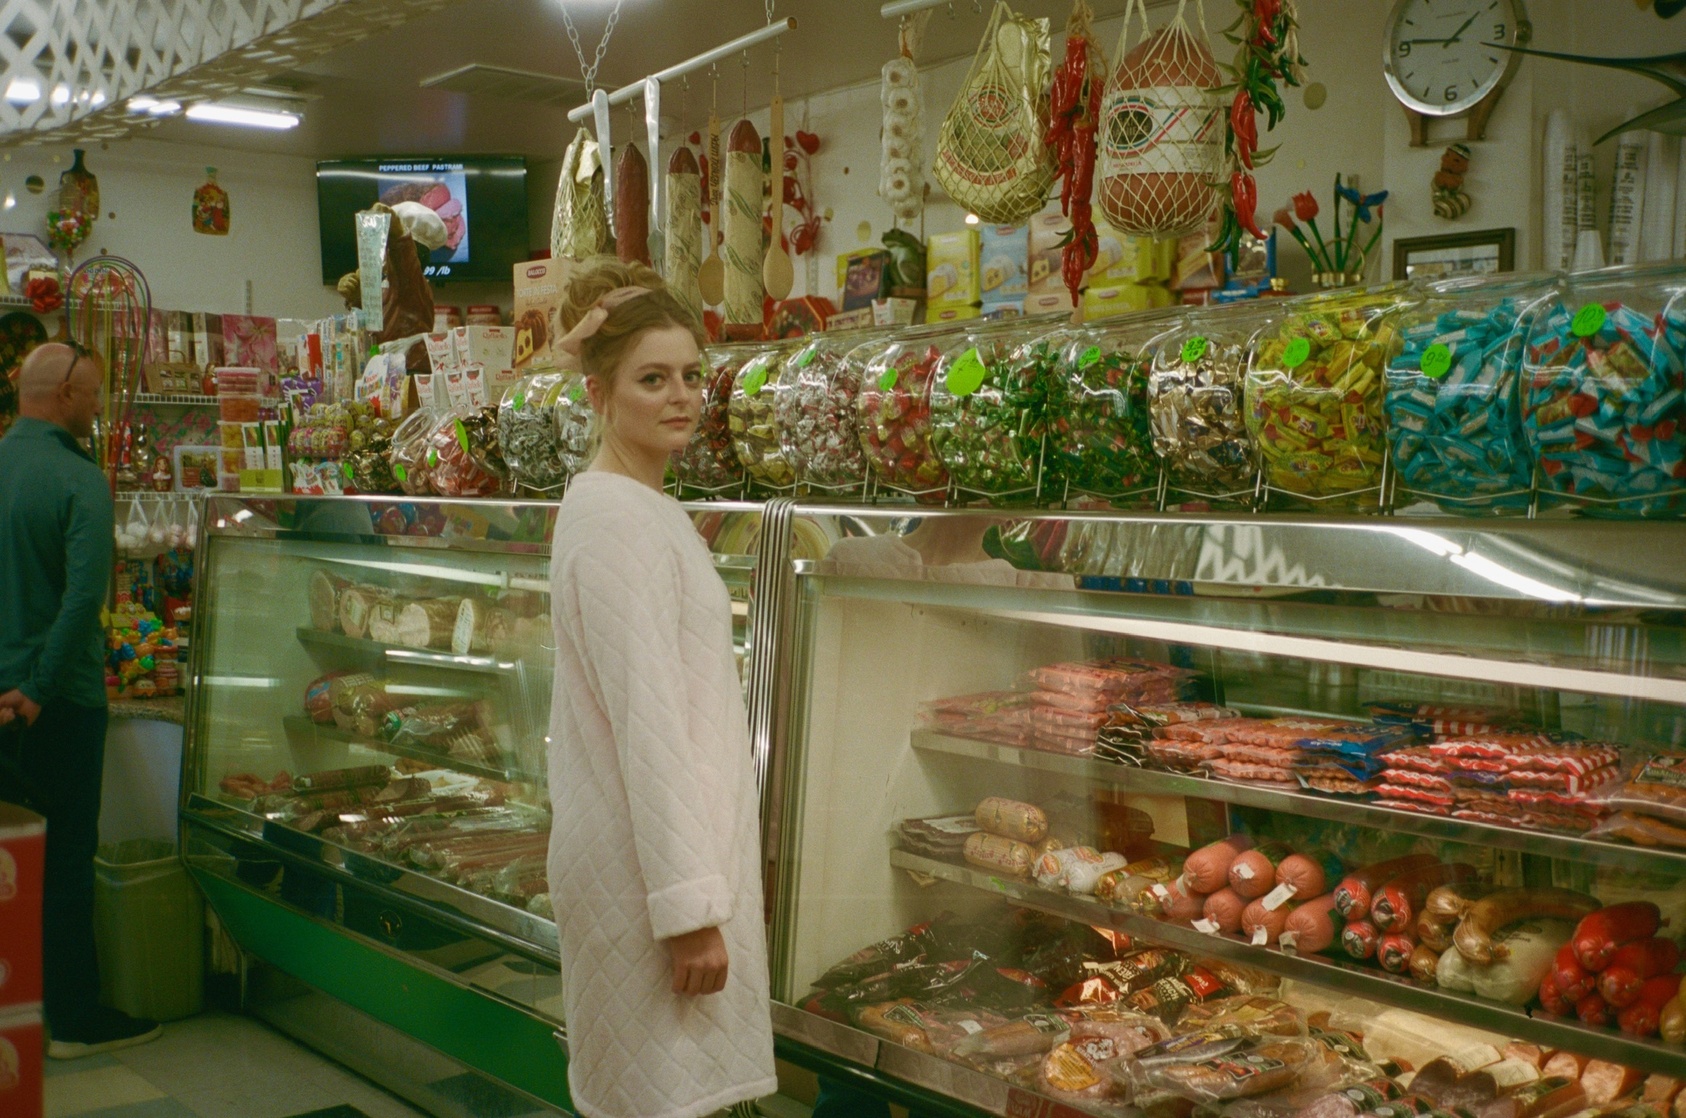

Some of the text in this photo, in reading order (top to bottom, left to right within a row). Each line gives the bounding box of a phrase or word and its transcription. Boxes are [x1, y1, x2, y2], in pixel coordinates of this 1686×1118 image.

[1493, 23, 1505, 40] 3
[1398, 41, 1411, 58] 9
[1444, 84, 1458, 101] 6
[378, 164, 412, 172] PEPPERED
